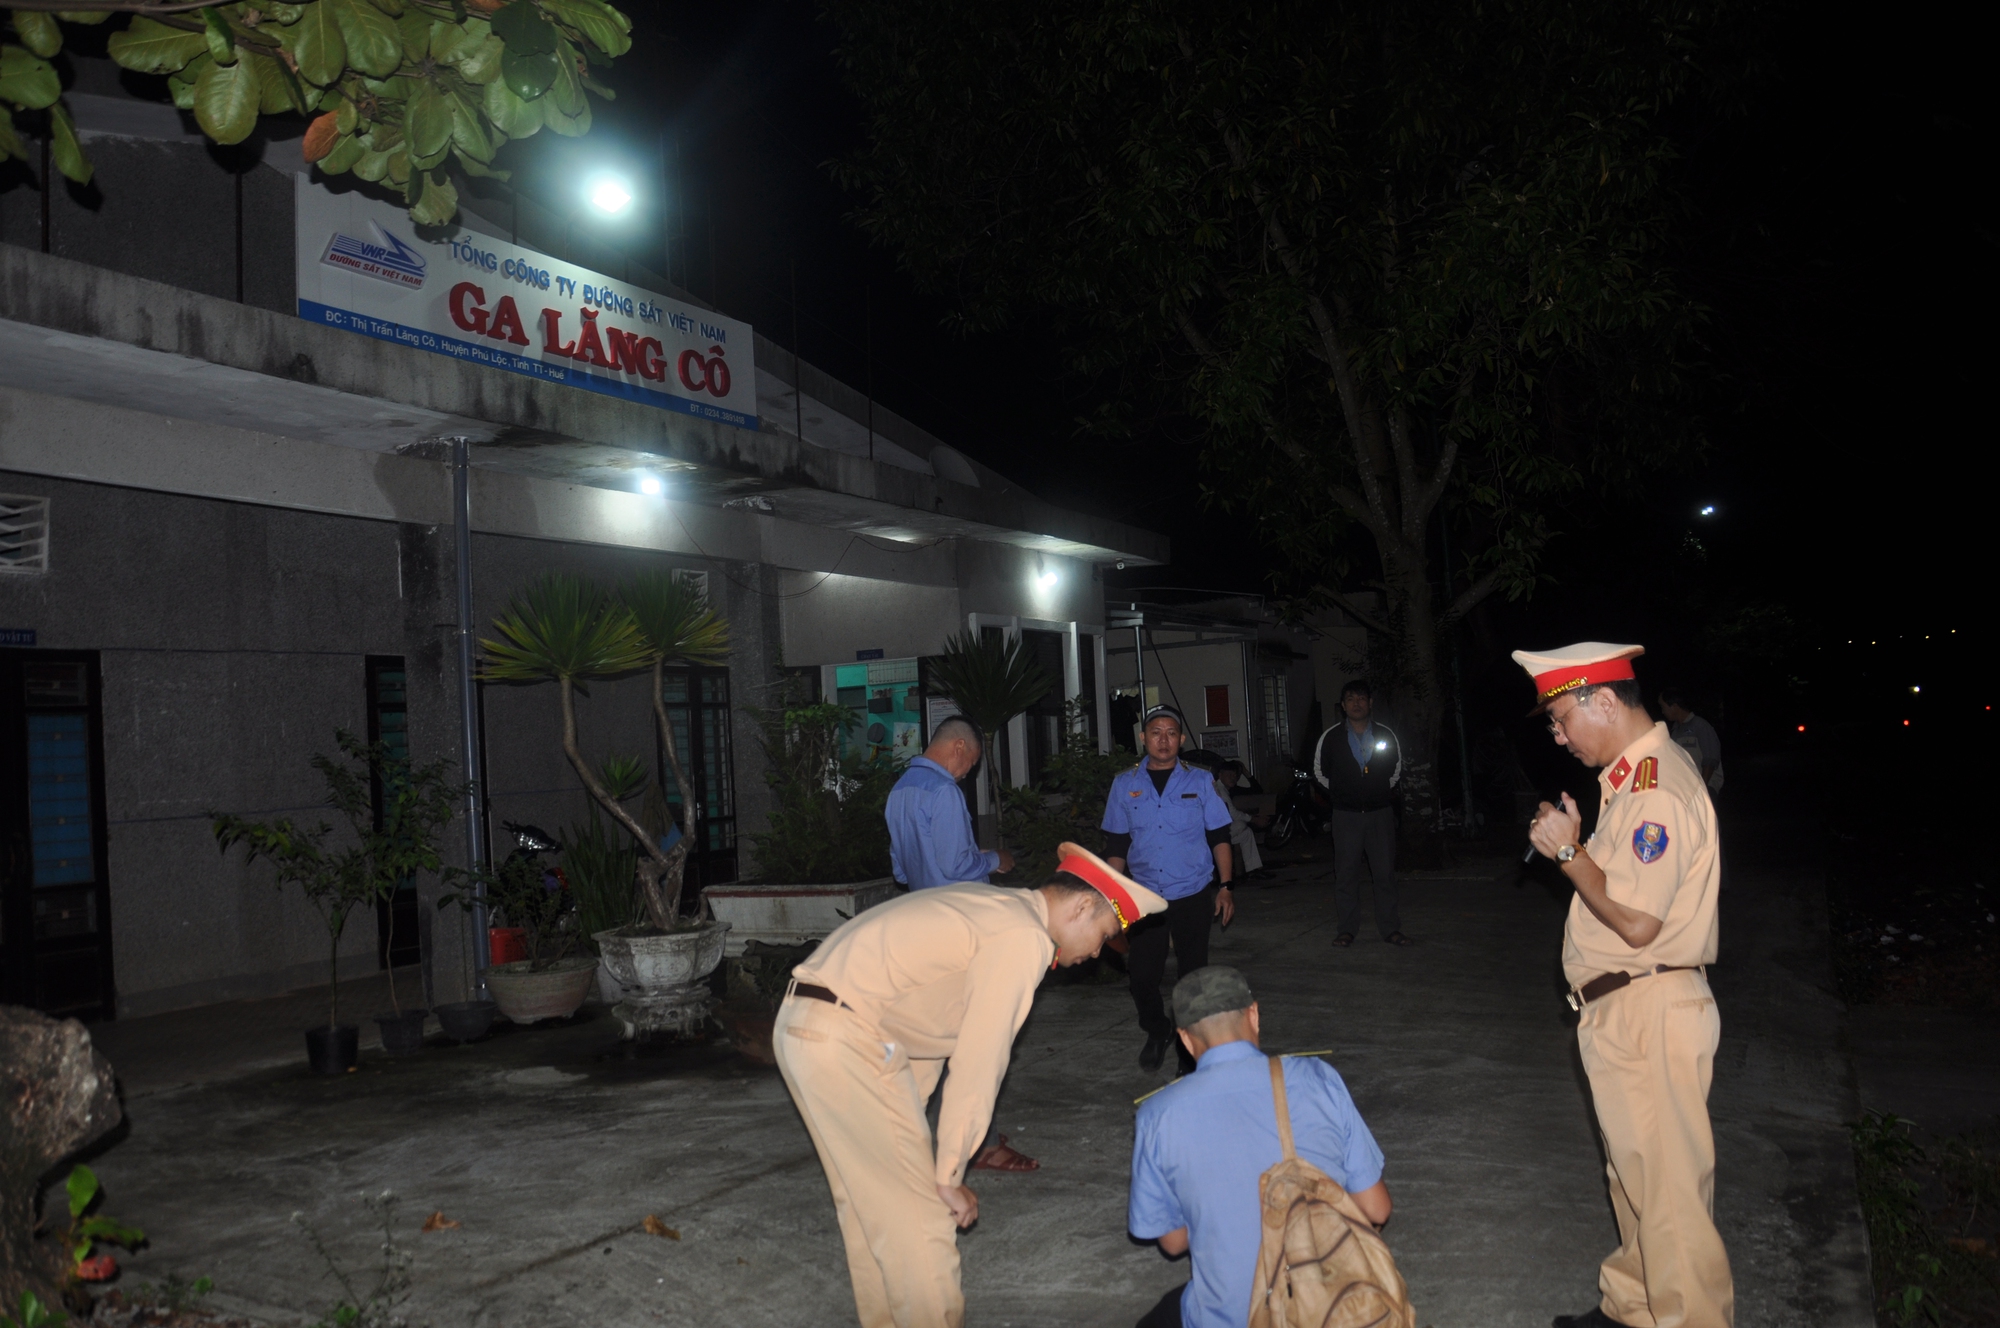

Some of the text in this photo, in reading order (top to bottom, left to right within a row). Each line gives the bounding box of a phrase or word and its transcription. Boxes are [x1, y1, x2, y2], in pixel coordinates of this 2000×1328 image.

[360, 242, 386, 260] VNR
[401, 274, 423, 286] NAM
[451, 235, 498, 271] TỔNG
[504, 258, 550, 288] CÔNG
[556, 275, 577, 297] TY
[638, 299, 663, 323] SẮT
[668, 312, 694, 335] VIỆT
[699, 322, 726, 343] NAM
[351, 316, 367, 333] Thị
[370, 321, 393, 337] Trấn
[396, 328, 419, 346] Lăng
[441, 340, 469, 356] Huyện
[472, 349, 489, 361] Phú
[449, 281, 731, 398] GA LĂNG CÔ
